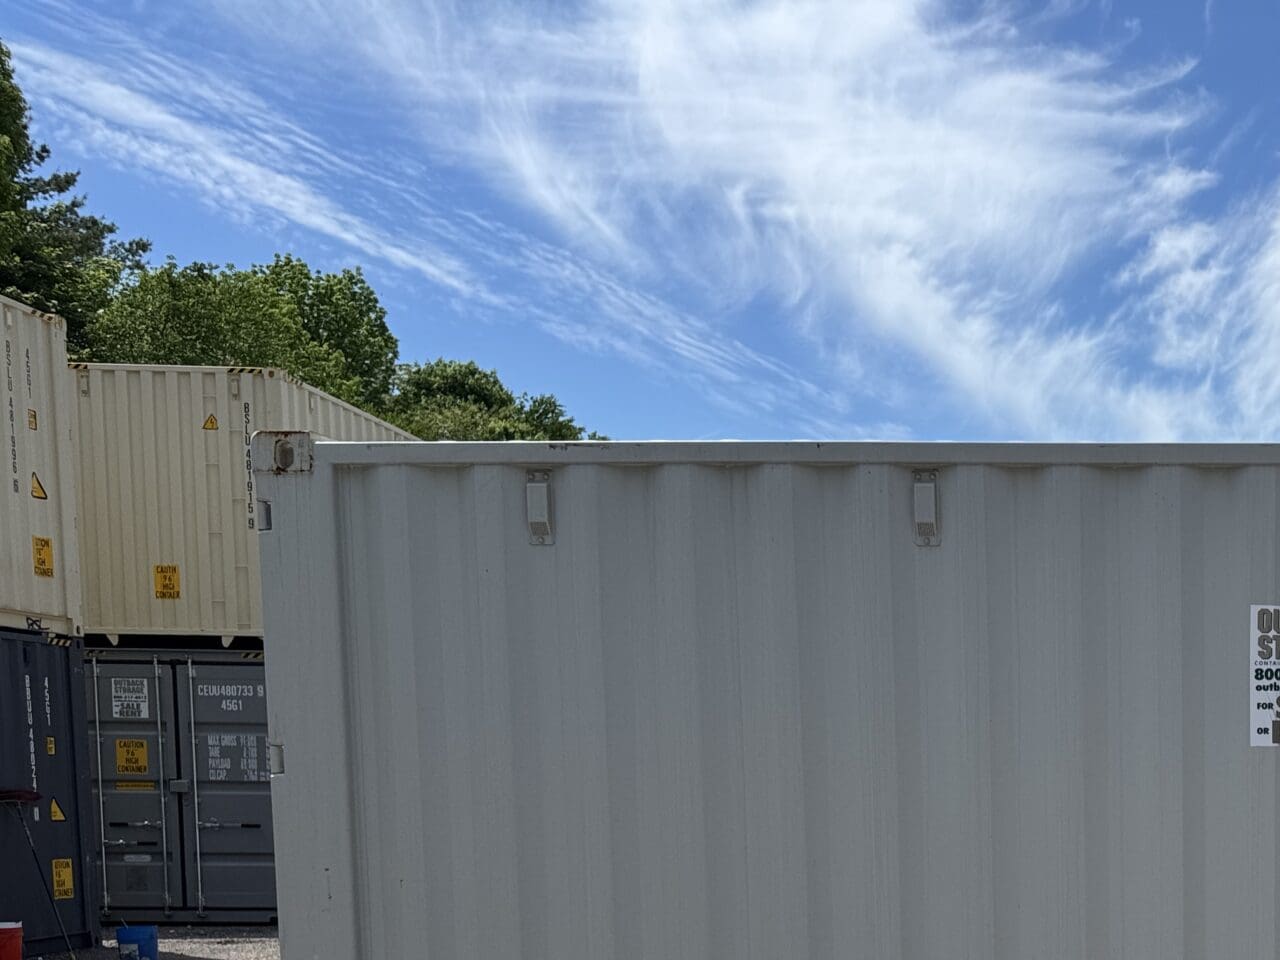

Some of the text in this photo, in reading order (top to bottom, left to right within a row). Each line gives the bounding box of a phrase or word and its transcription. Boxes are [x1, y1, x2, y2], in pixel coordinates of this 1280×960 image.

[246, 449, 254, 513] 481915
[113, 680, 145, 688] OUTBACK
[197, 684, 264, 697] CEUU480733 9
[220, 699, 242, 711] 45G1
[1257, 702, 1274, 710] FOR
[1256, 727, 1269, 735] OR
[119, 740, 144, 748] CAUTION
